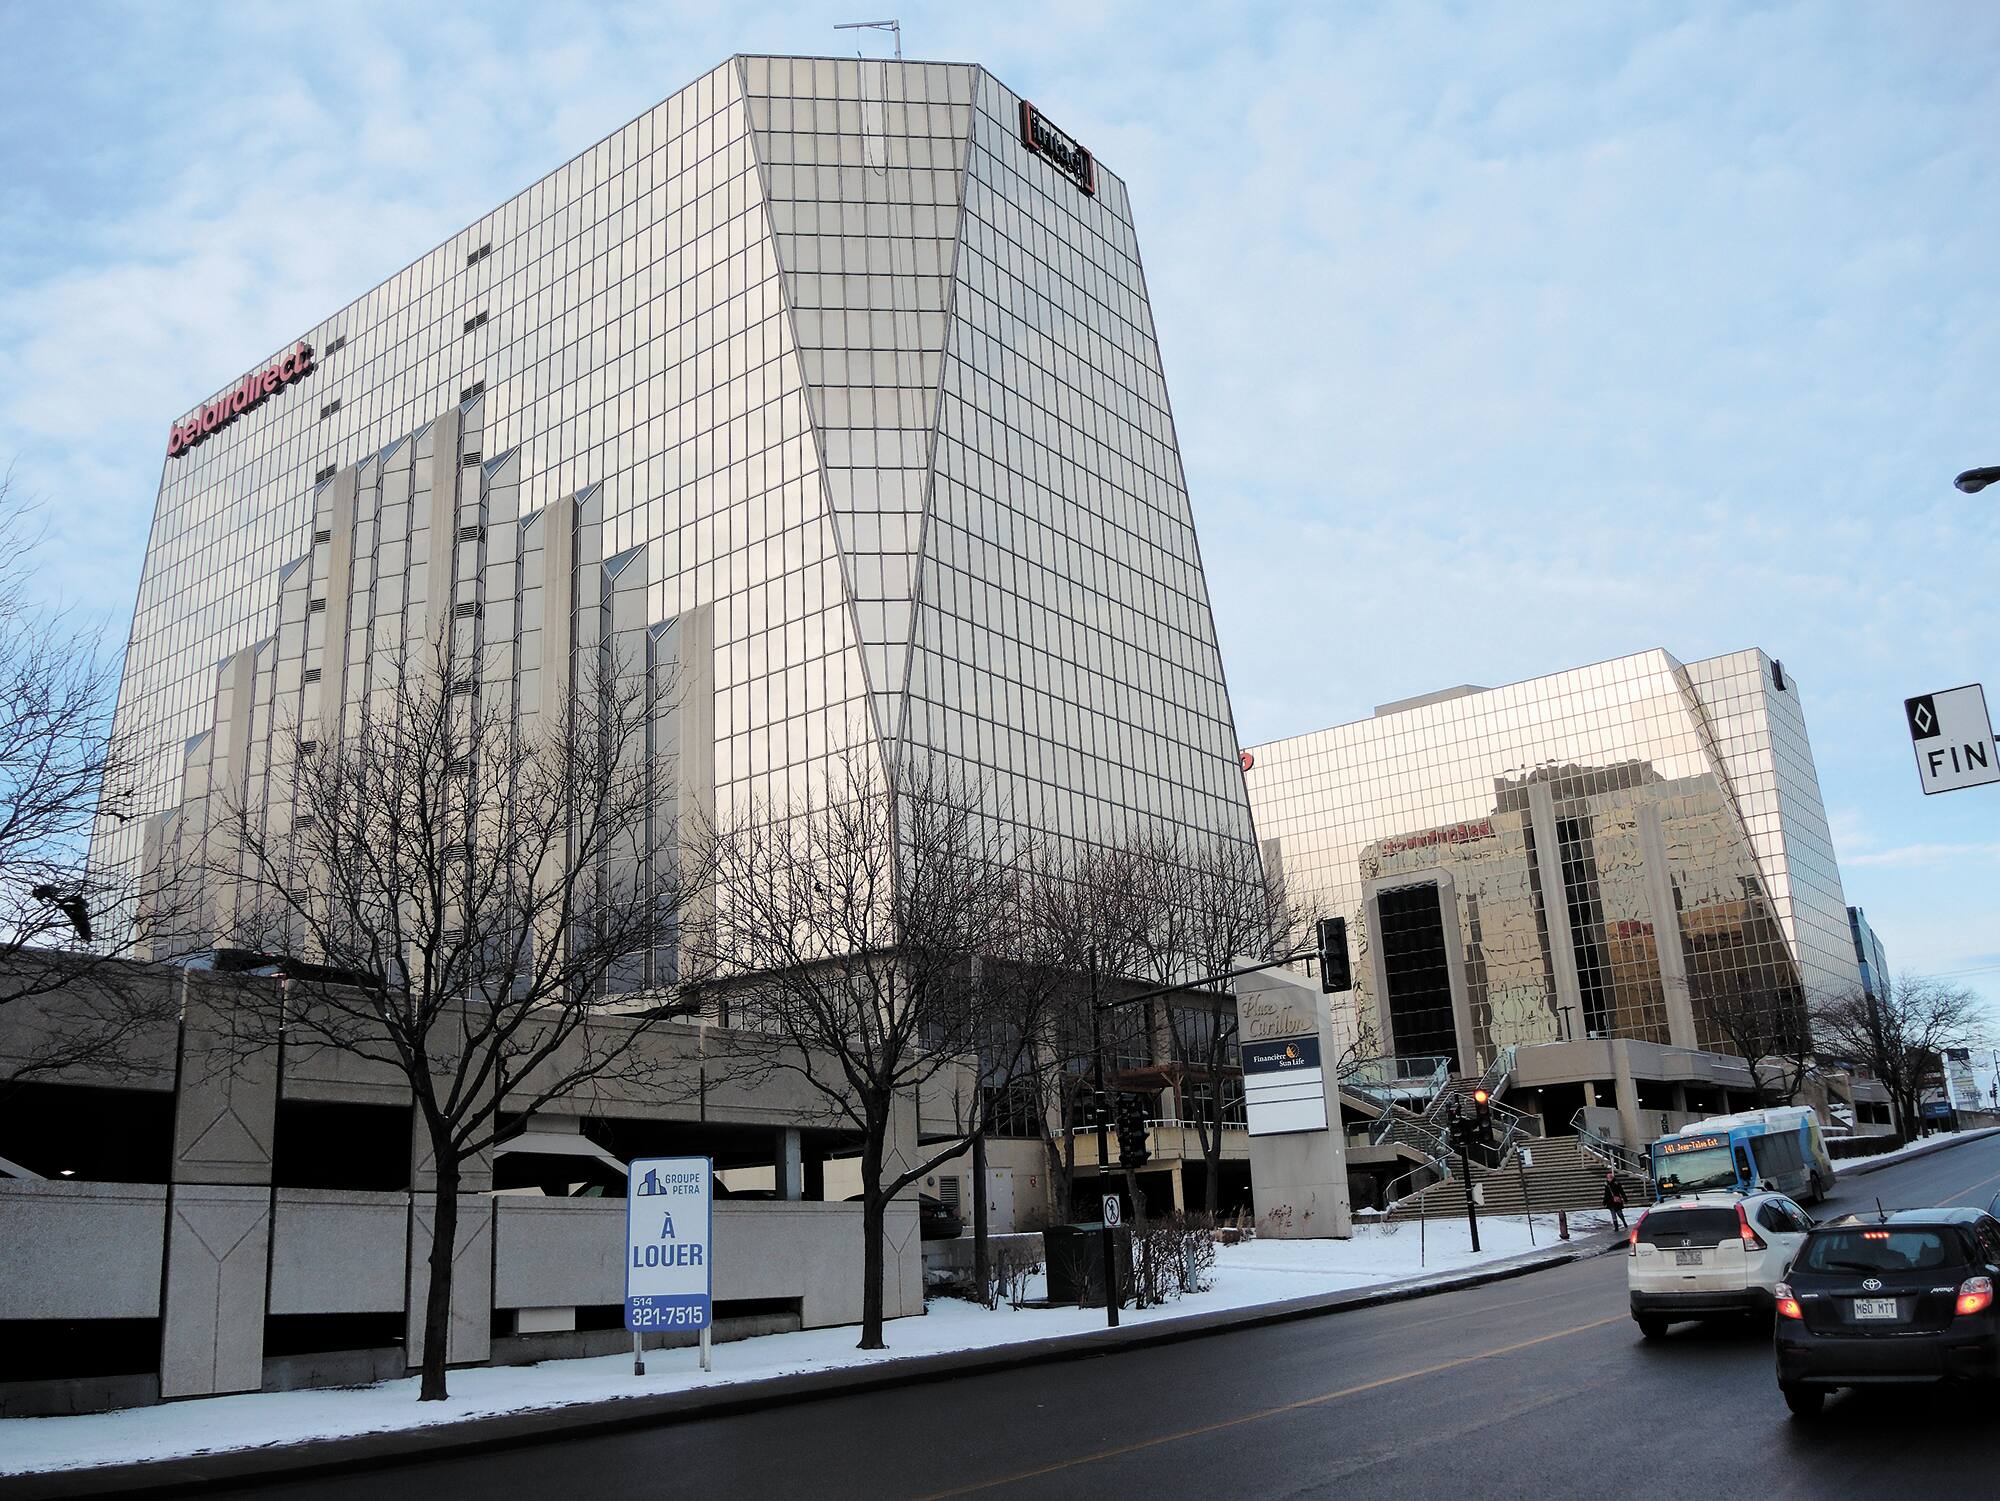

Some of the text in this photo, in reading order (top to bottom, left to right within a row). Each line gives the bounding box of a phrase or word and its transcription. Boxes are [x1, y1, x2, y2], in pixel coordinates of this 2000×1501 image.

[1928, 741, 1988, 778] FIN
[1292, 1057, 1305, 1066] Life
[665, 1173, 700, 1184] GROUPE
[672, 1185, 700, 1195] PETRA
[661, 1211, 676, 1239] À
[633, 1243, 703, 1268] LOUER
[633, 1297, 653, 1306] 514
[632, 1306, 703, 1326] 321-7515
